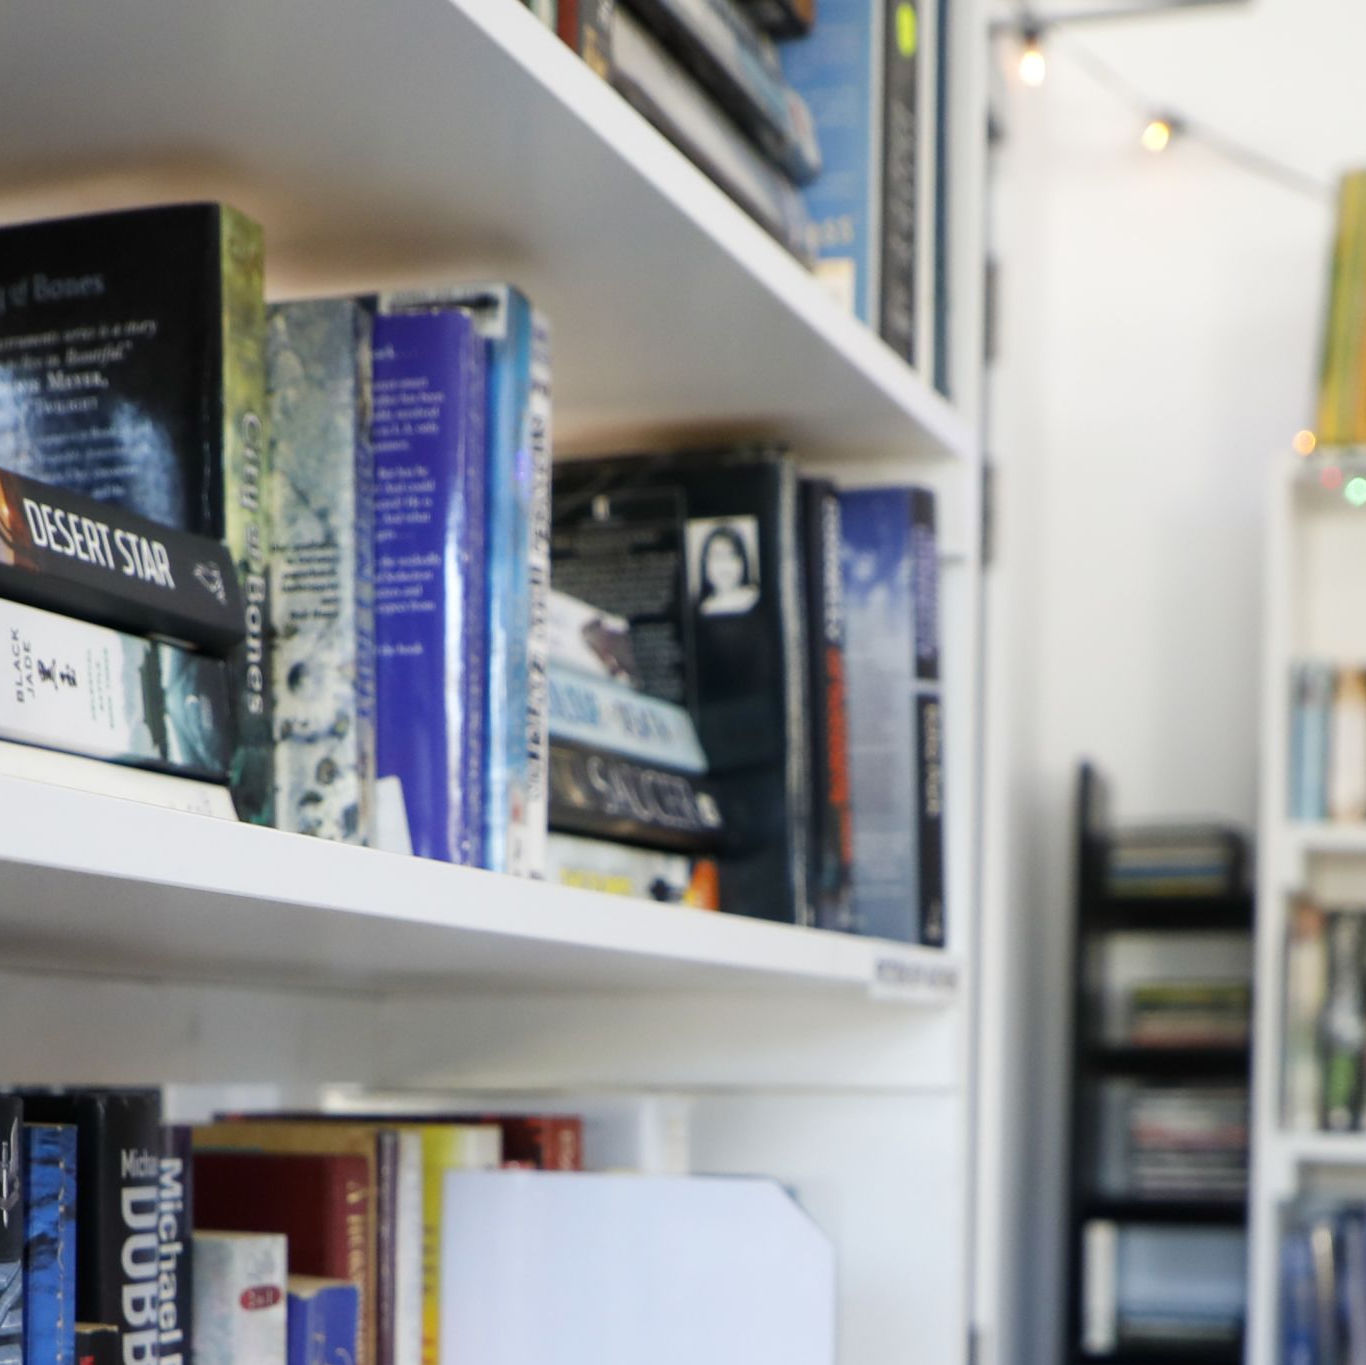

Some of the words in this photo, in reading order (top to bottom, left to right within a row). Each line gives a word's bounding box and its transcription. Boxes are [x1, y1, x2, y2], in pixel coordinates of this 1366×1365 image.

[32, 271, 106, 301] Bones
[22, 497, 116, 570] DESERT
[111, 528, 177, 590] STAR
[9, 626, 26, 705] BLACK
[22, 638, 35, 699] JADE
[244, 574, 267, 716] Bones
[157, 1158, 184, 1345] Michael
